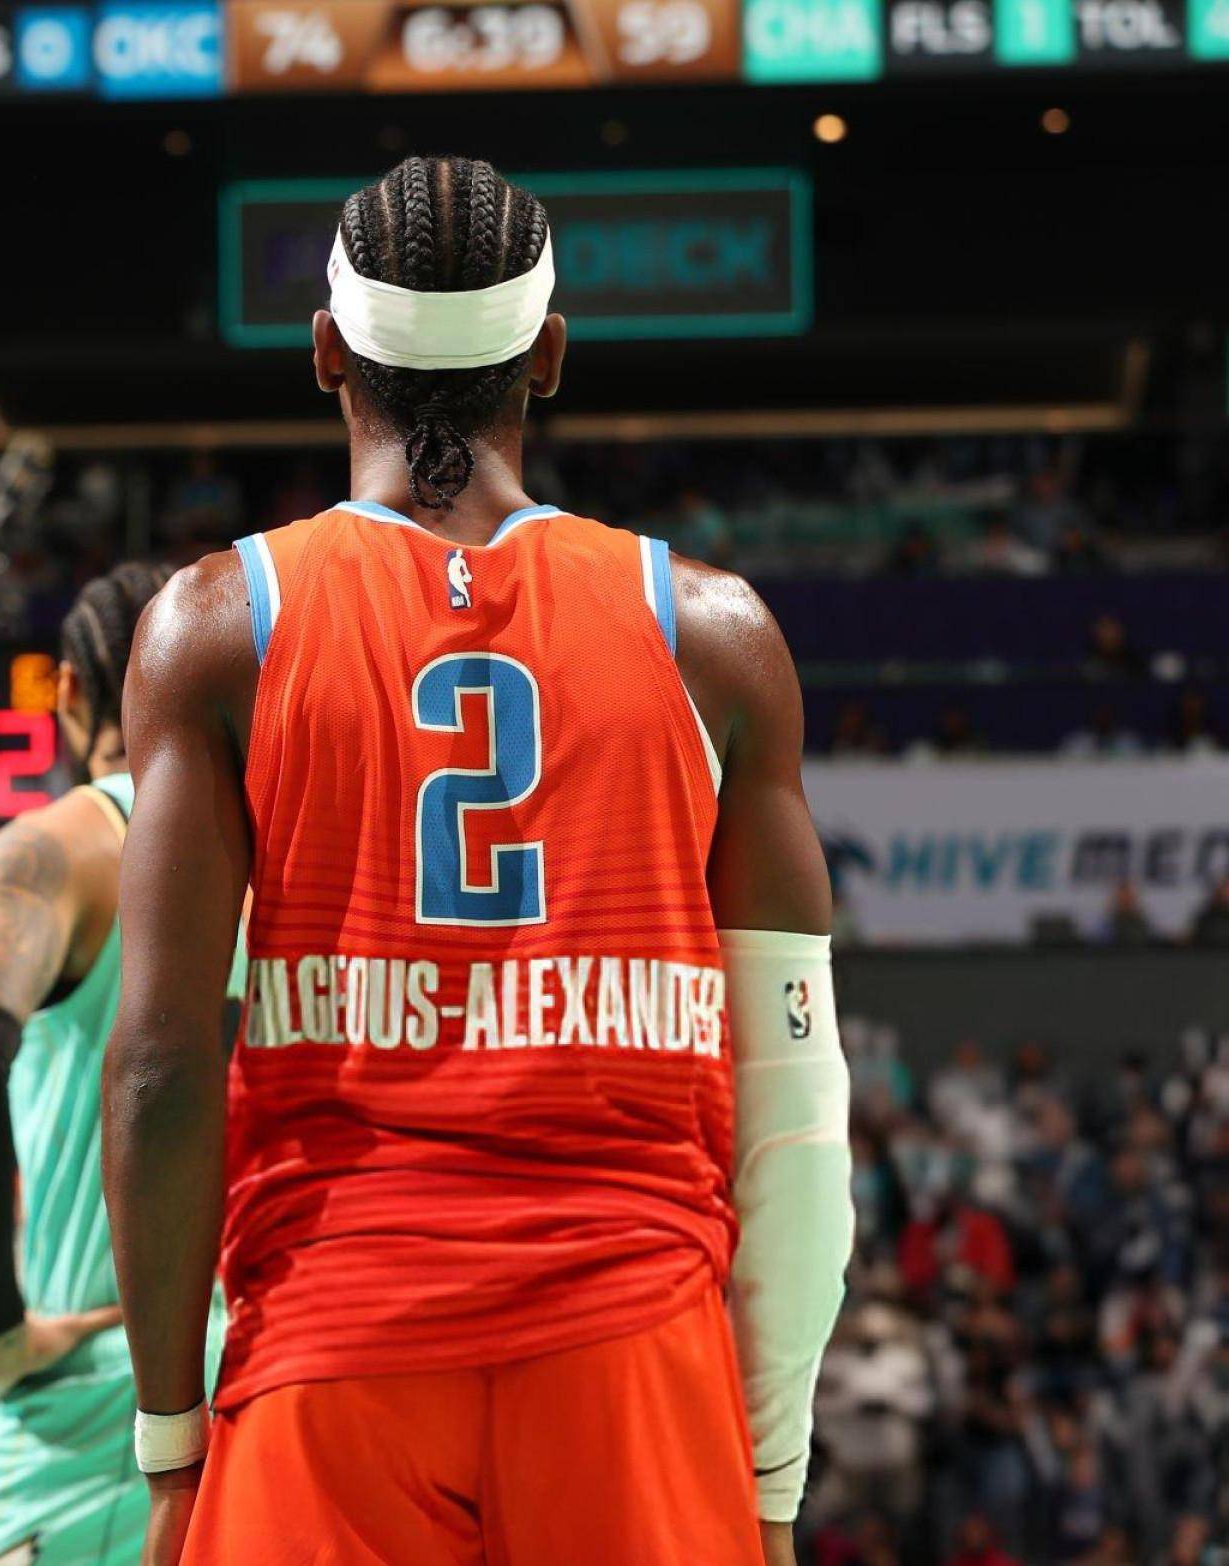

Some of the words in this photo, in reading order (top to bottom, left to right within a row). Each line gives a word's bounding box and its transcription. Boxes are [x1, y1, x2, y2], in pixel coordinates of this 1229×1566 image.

[92, 15, 222, 80] OKC
[254, 9, 343, 74] 74
[616, 1, 712, 66] 59
[890, 0, 993, 55] FLS
[1076, 0, 1182, 50] TOL
[412, 652, 547, 927] 2
[884, 829, 1062, 891] HIVE
